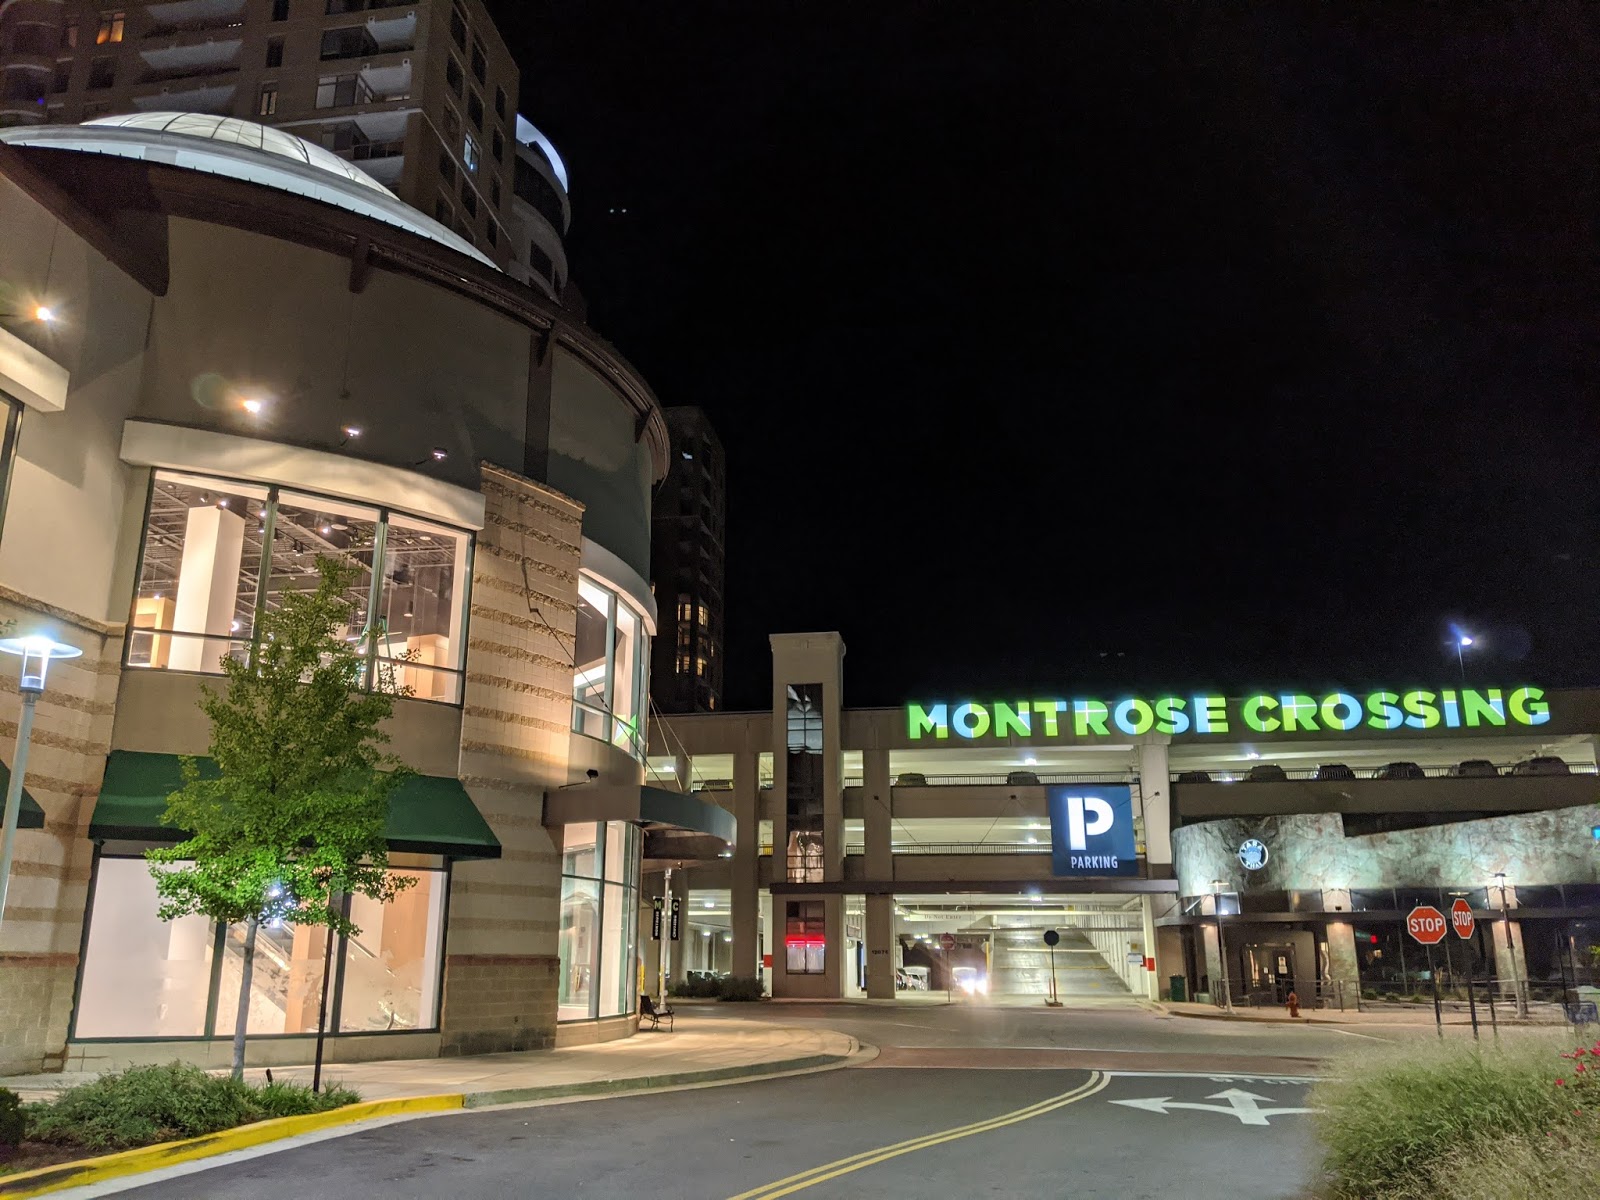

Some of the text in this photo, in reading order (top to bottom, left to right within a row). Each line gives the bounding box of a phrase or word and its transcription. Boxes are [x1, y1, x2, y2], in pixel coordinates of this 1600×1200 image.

[908, 687, 1551, 739] MONTROSE CROSSING
[1067, 797, 1114, 851] P
[1070, 855, 1118, 869] PARKING
[1410, 917, 1443, 932] STOP
[1453, 911, 1472, 926] STOP
